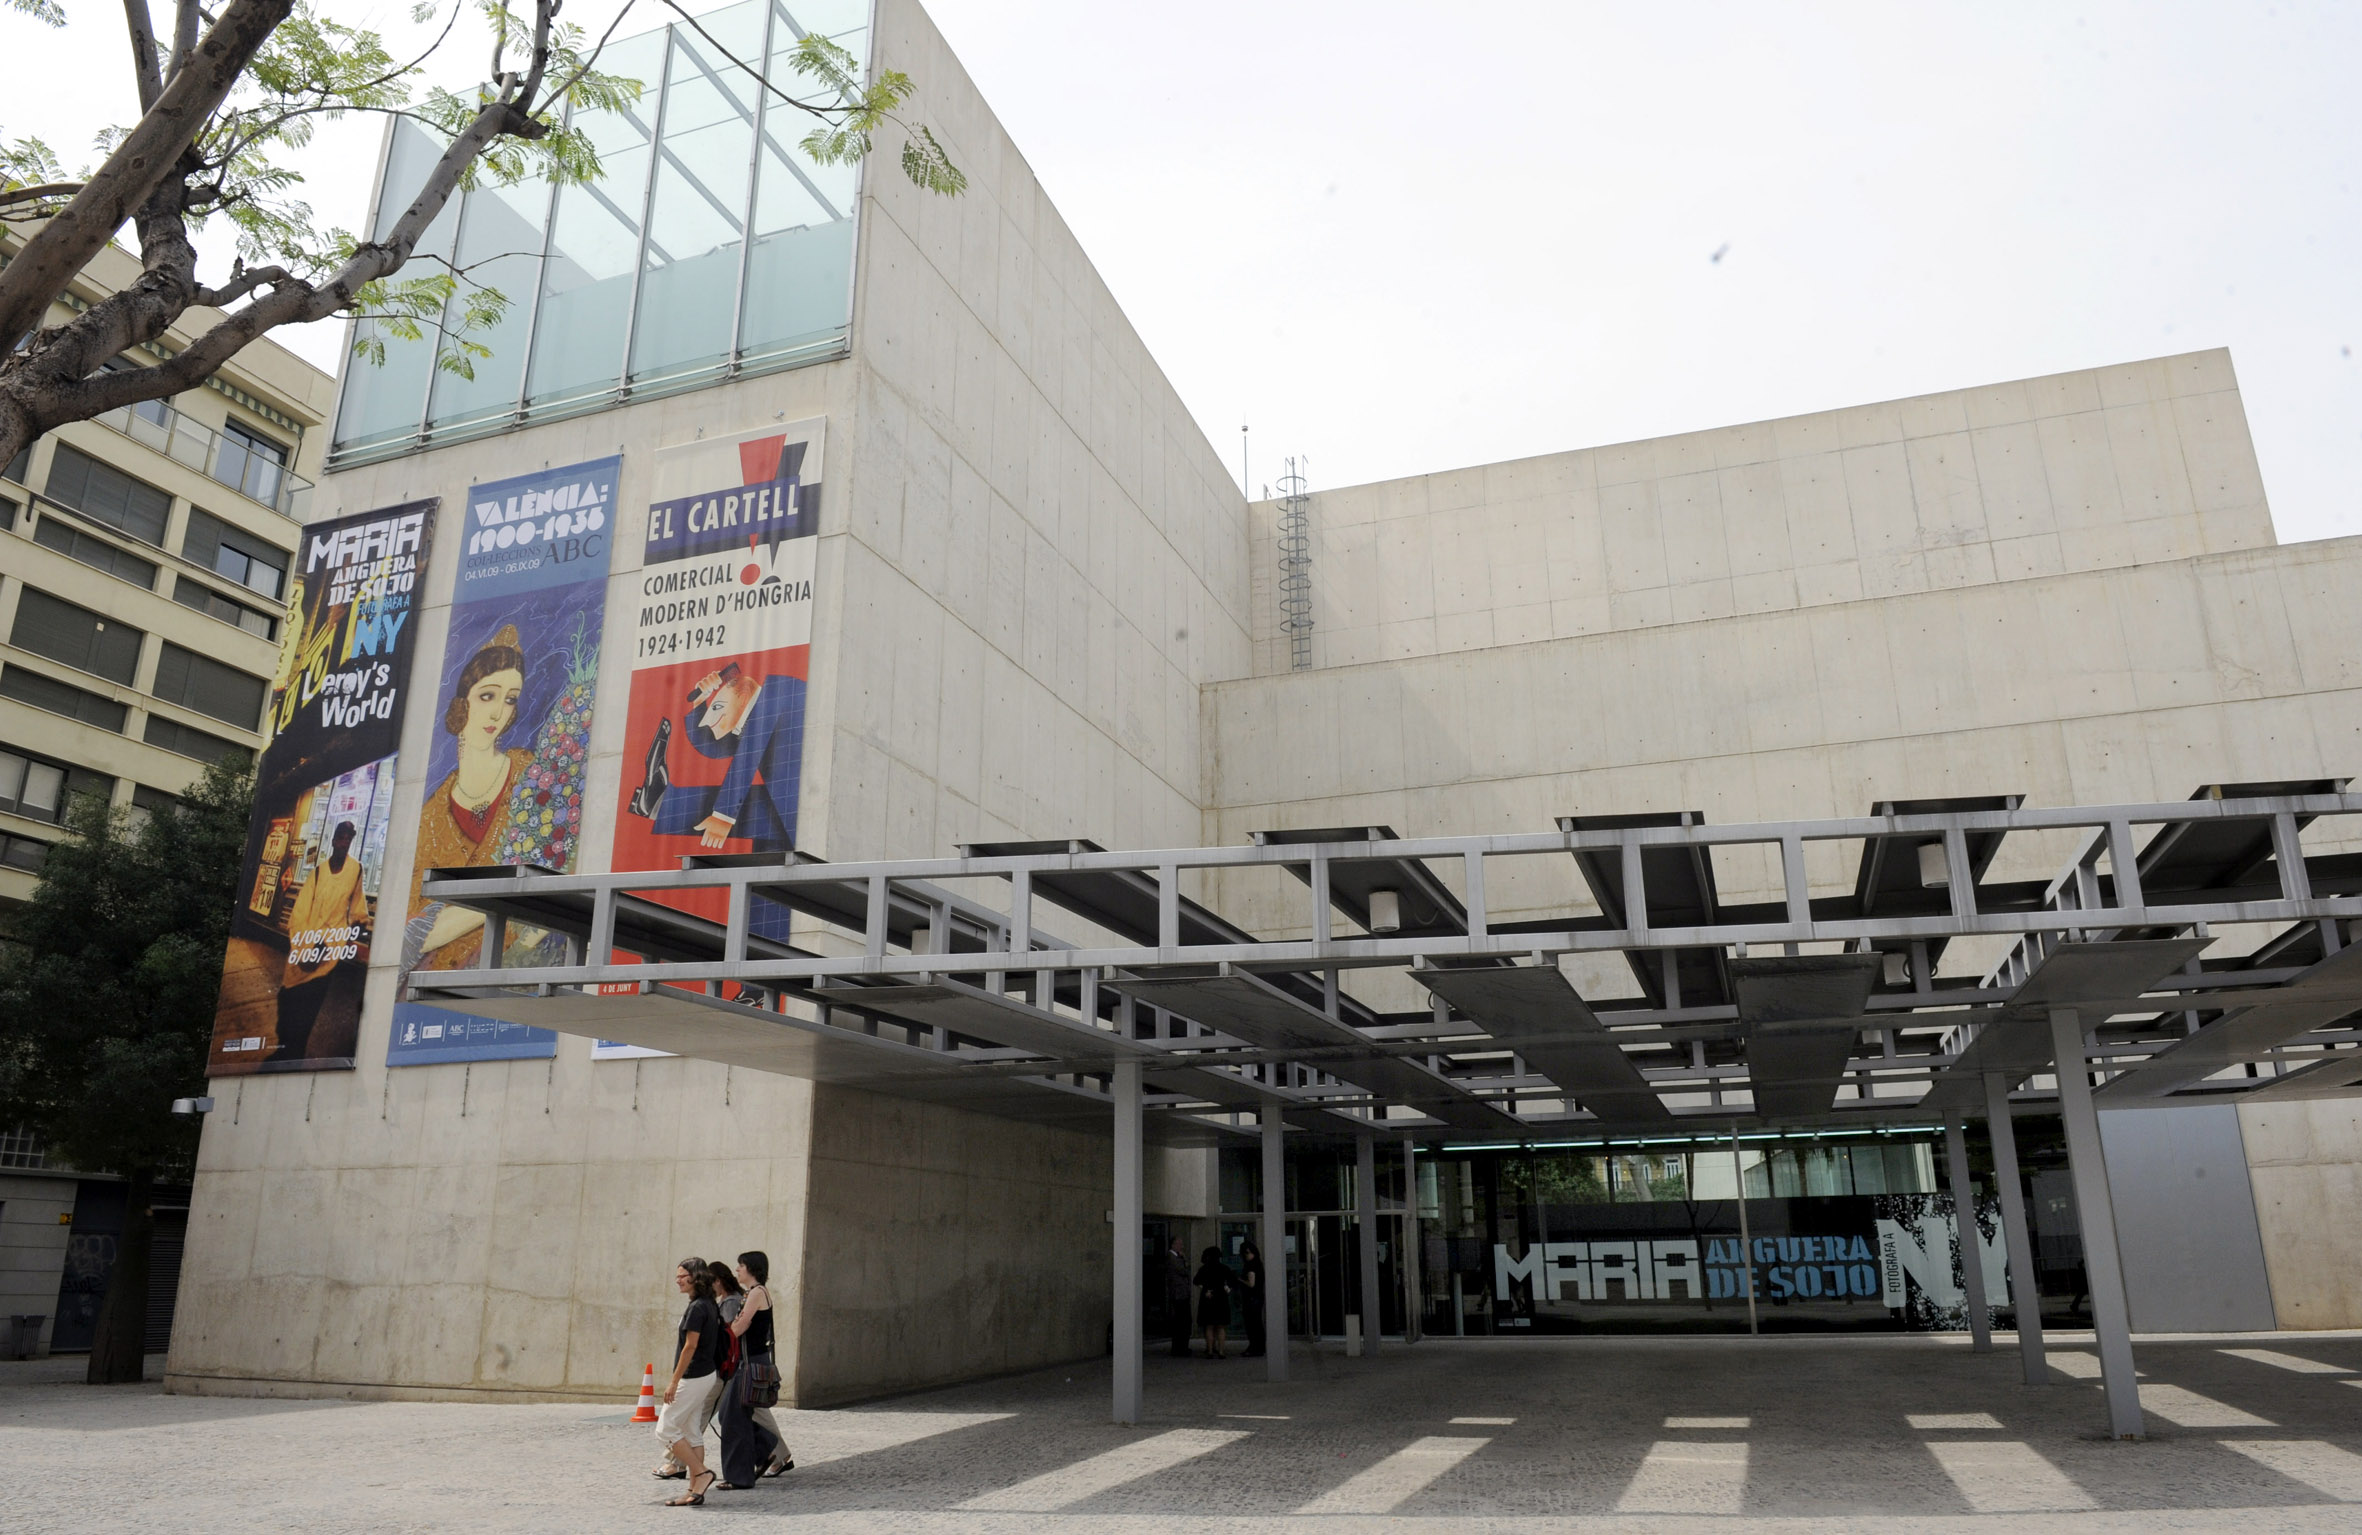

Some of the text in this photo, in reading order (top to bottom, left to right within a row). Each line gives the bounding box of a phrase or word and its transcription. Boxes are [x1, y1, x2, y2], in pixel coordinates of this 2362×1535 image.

[648, 483, 800, 542] EL CARTELL
[306, 512, 425, 573] MARIA
[468, 506, 605, 556] 1900-1936
[541, 534, 603, 567] ABC
[333, 554, 416, 585] ANGUERA
[643, 563, 733, 597] COMERCIAL
[328, 571, 416, 607] DE SOJO
[404, 594, 411, 608] A
[639, 580, 812, 628] MODERN D'HONGRIA
[350, 610, 409, 659] NY
[302, 661, 391, 701] Leroy's
[322, 688, 397, 728] World
[291, 926, 360, 947] 4/06/2009
[288, 944, 358, 966] 6/09/2009
[602, 983, 632, 993] 4 DE JUNY
[1705, 1235, 1873, 1264] ANGUERA
[1882, 1232, 1895, 1240] A
[1493, 1239, 1702, 1301] MARIA
[1706, 1264, 1878, 1299] DE SOJO
